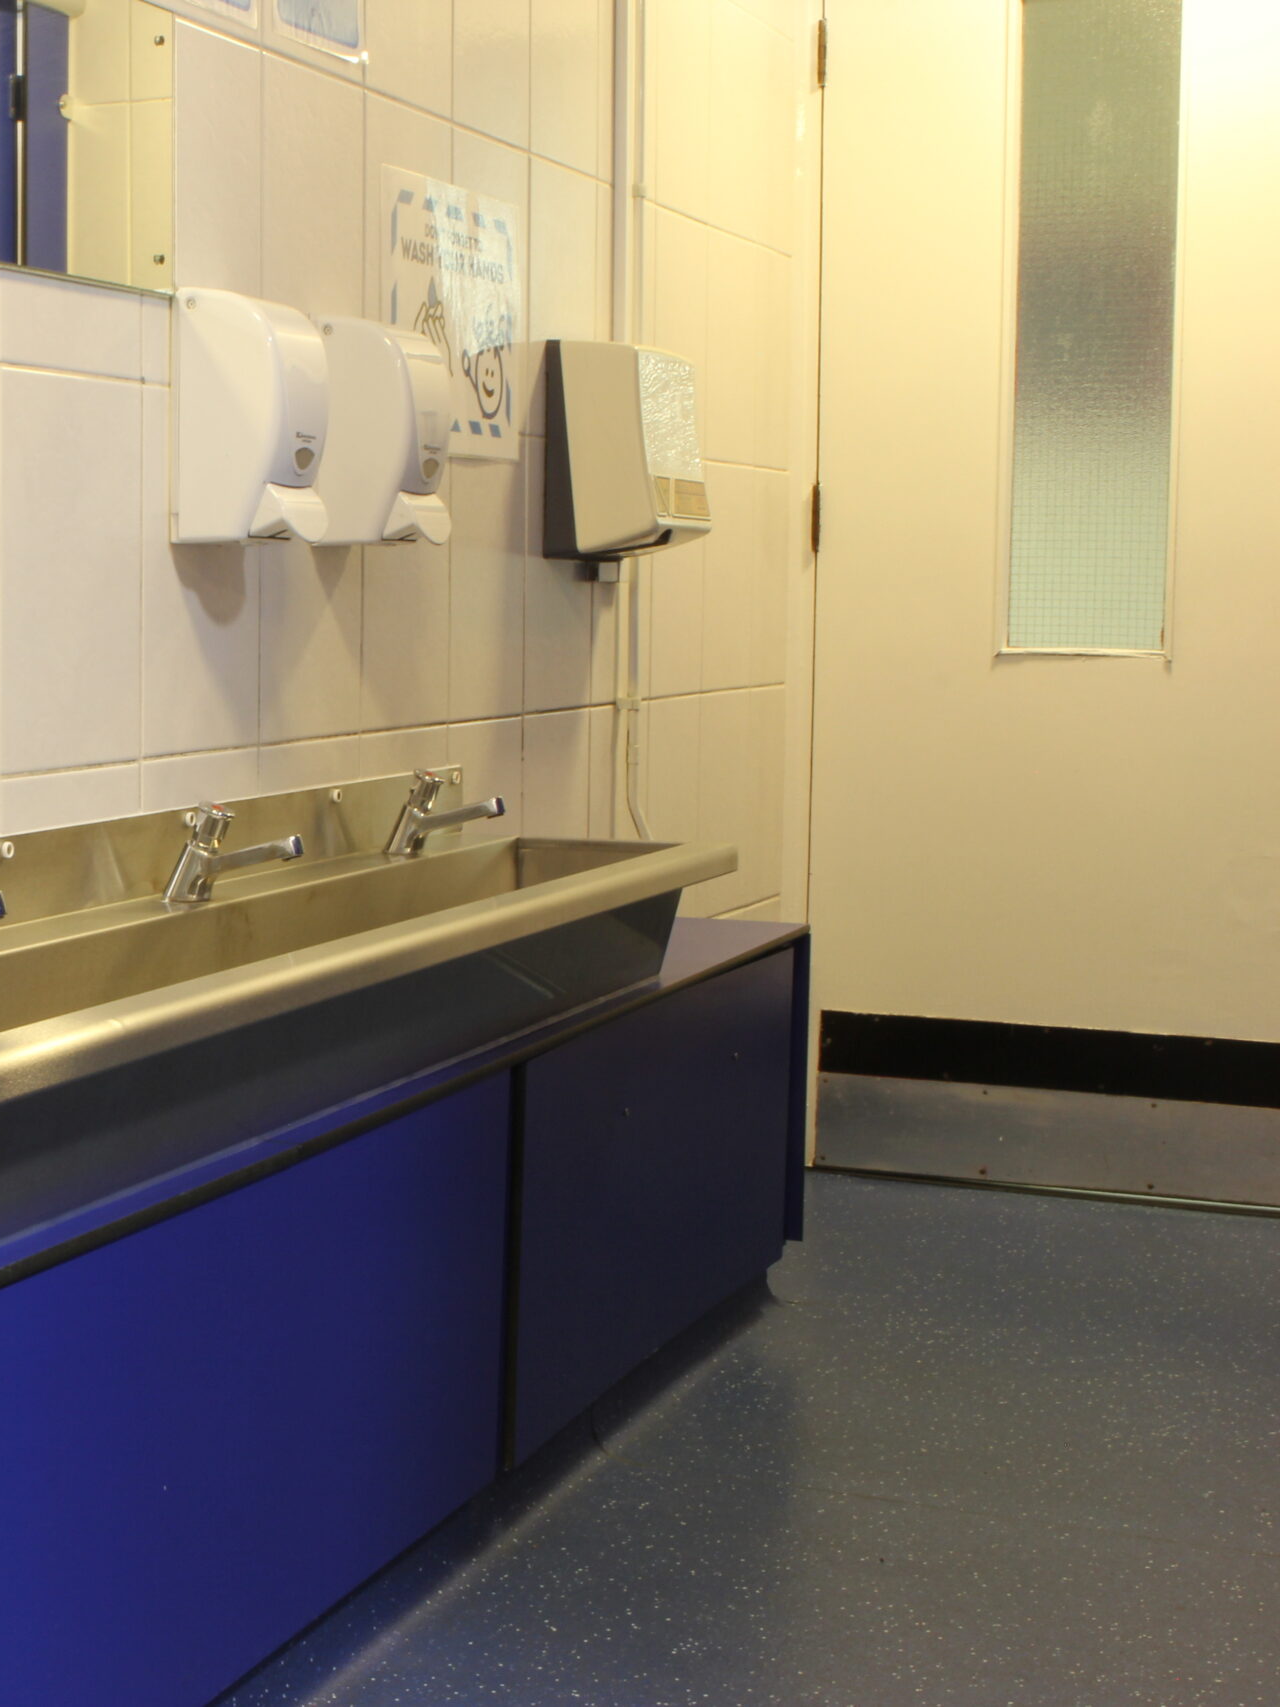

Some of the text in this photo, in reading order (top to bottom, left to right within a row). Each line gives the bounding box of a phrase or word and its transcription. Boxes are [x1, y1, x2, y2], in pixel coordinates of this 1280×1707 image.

[424, 223, 448, 242] DON
[401, 236, 434, 267] WASH
[467, 256, 505, 285] HANDS
